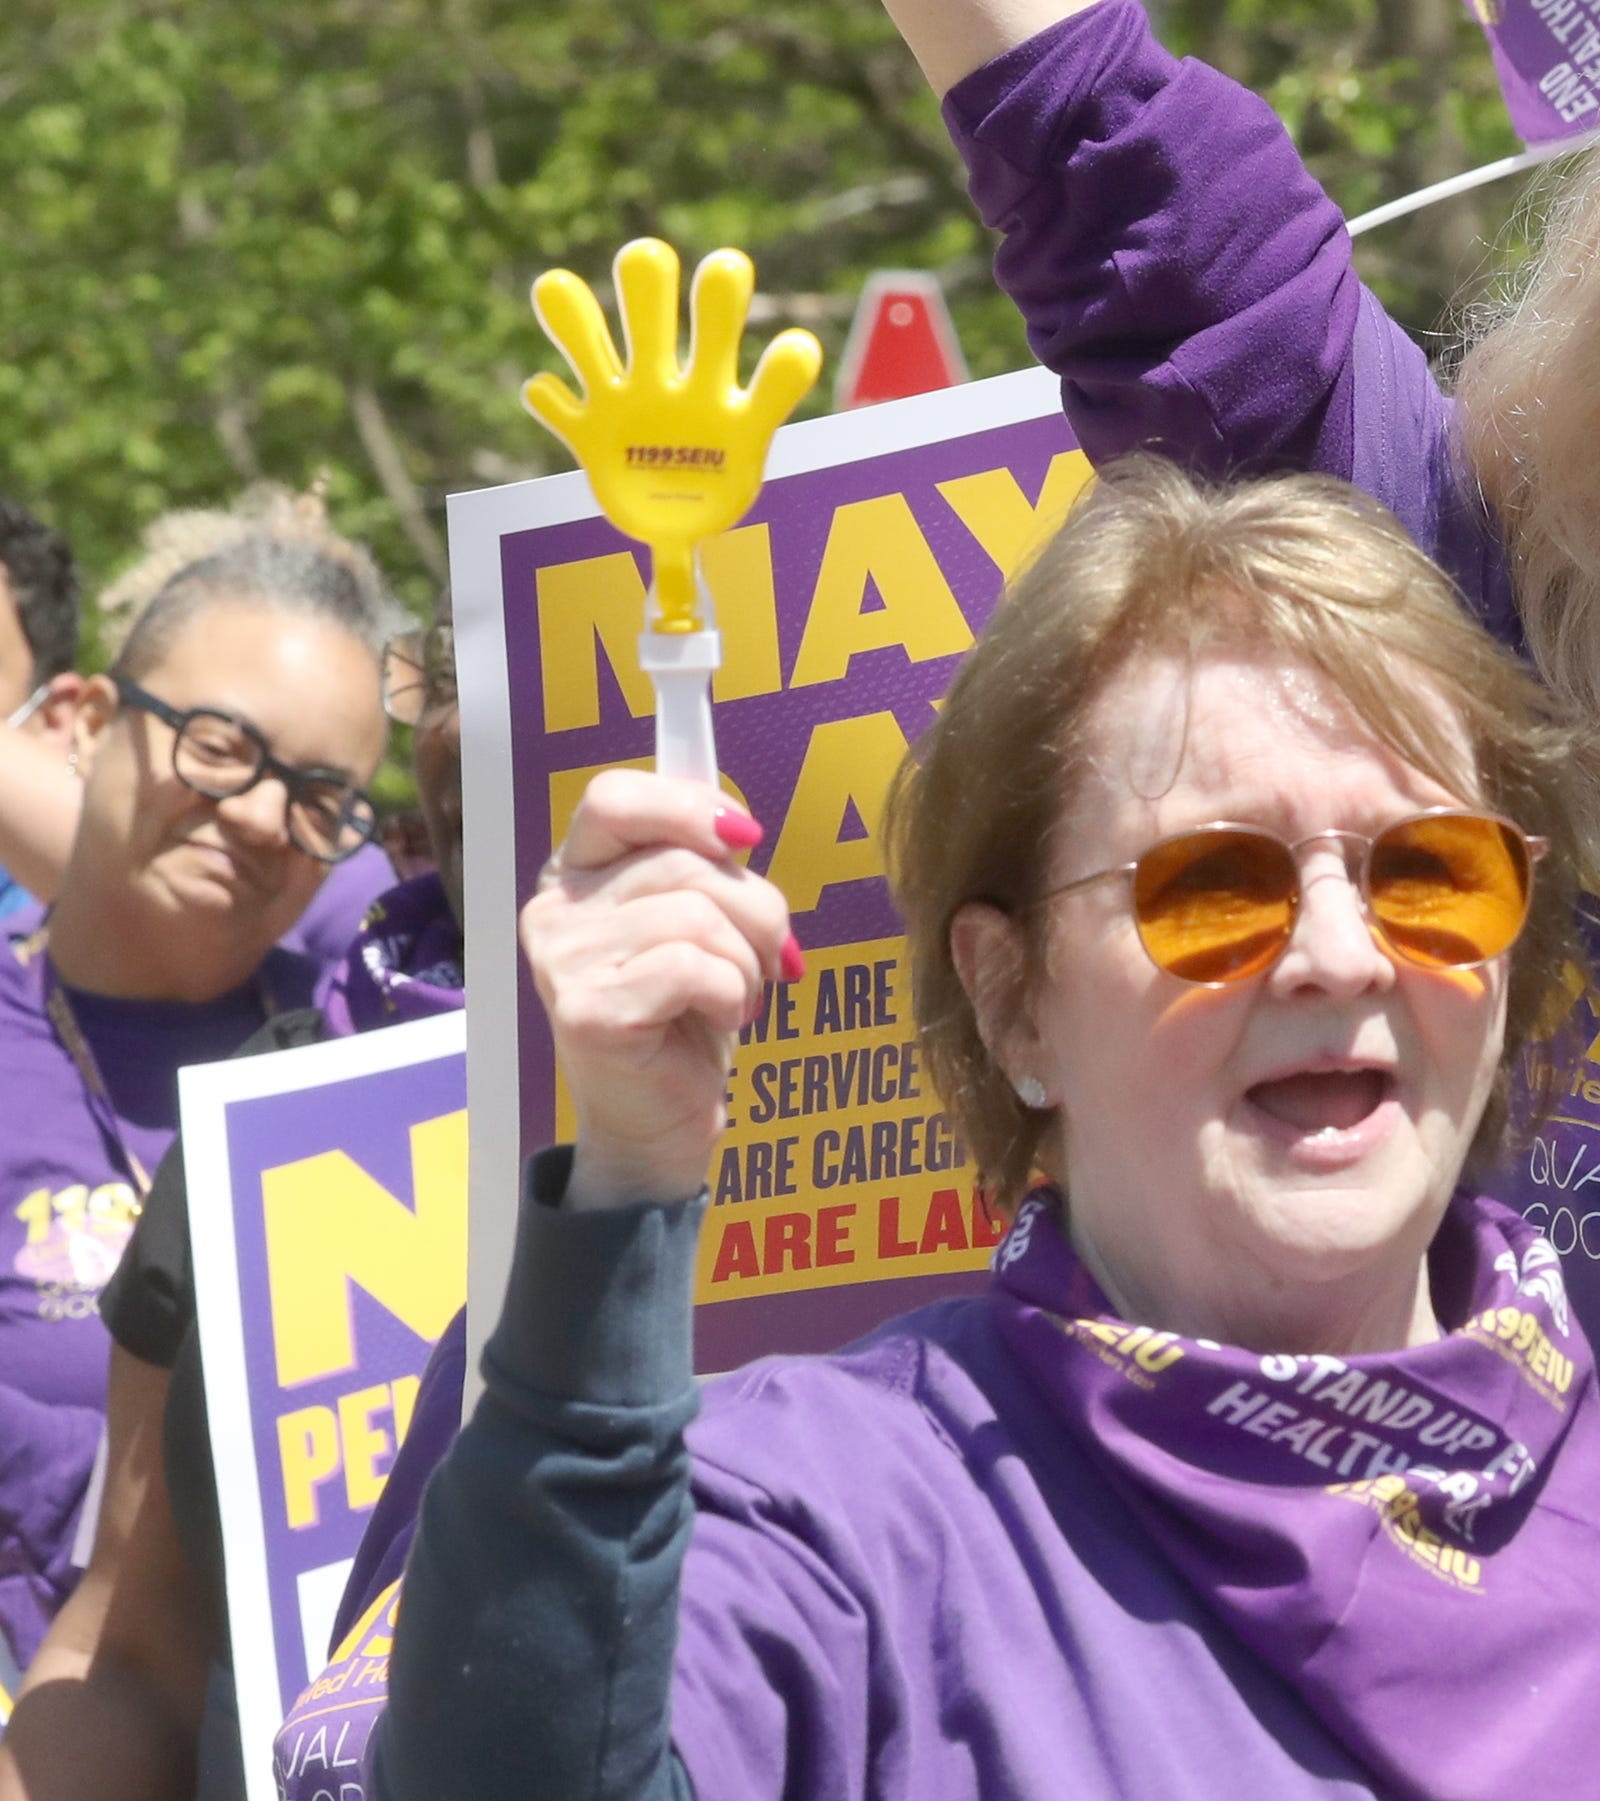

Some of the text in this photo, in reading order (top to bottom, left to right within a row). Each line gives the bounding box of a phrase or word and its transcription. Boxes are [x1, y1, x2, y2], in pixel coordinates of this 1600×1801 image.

[1539, 62, 1600, 123] END
[626, 447, 725, 466] 1199SEIU
[813, 960, 897, 1036] ARE
[750, 1041, 920, 1124] SERVICE
[715, 1136, 800, 1206] ARE
[711, 1204, 856, 1283] ARE
[1418, 1412, 1496, 1455] UP
